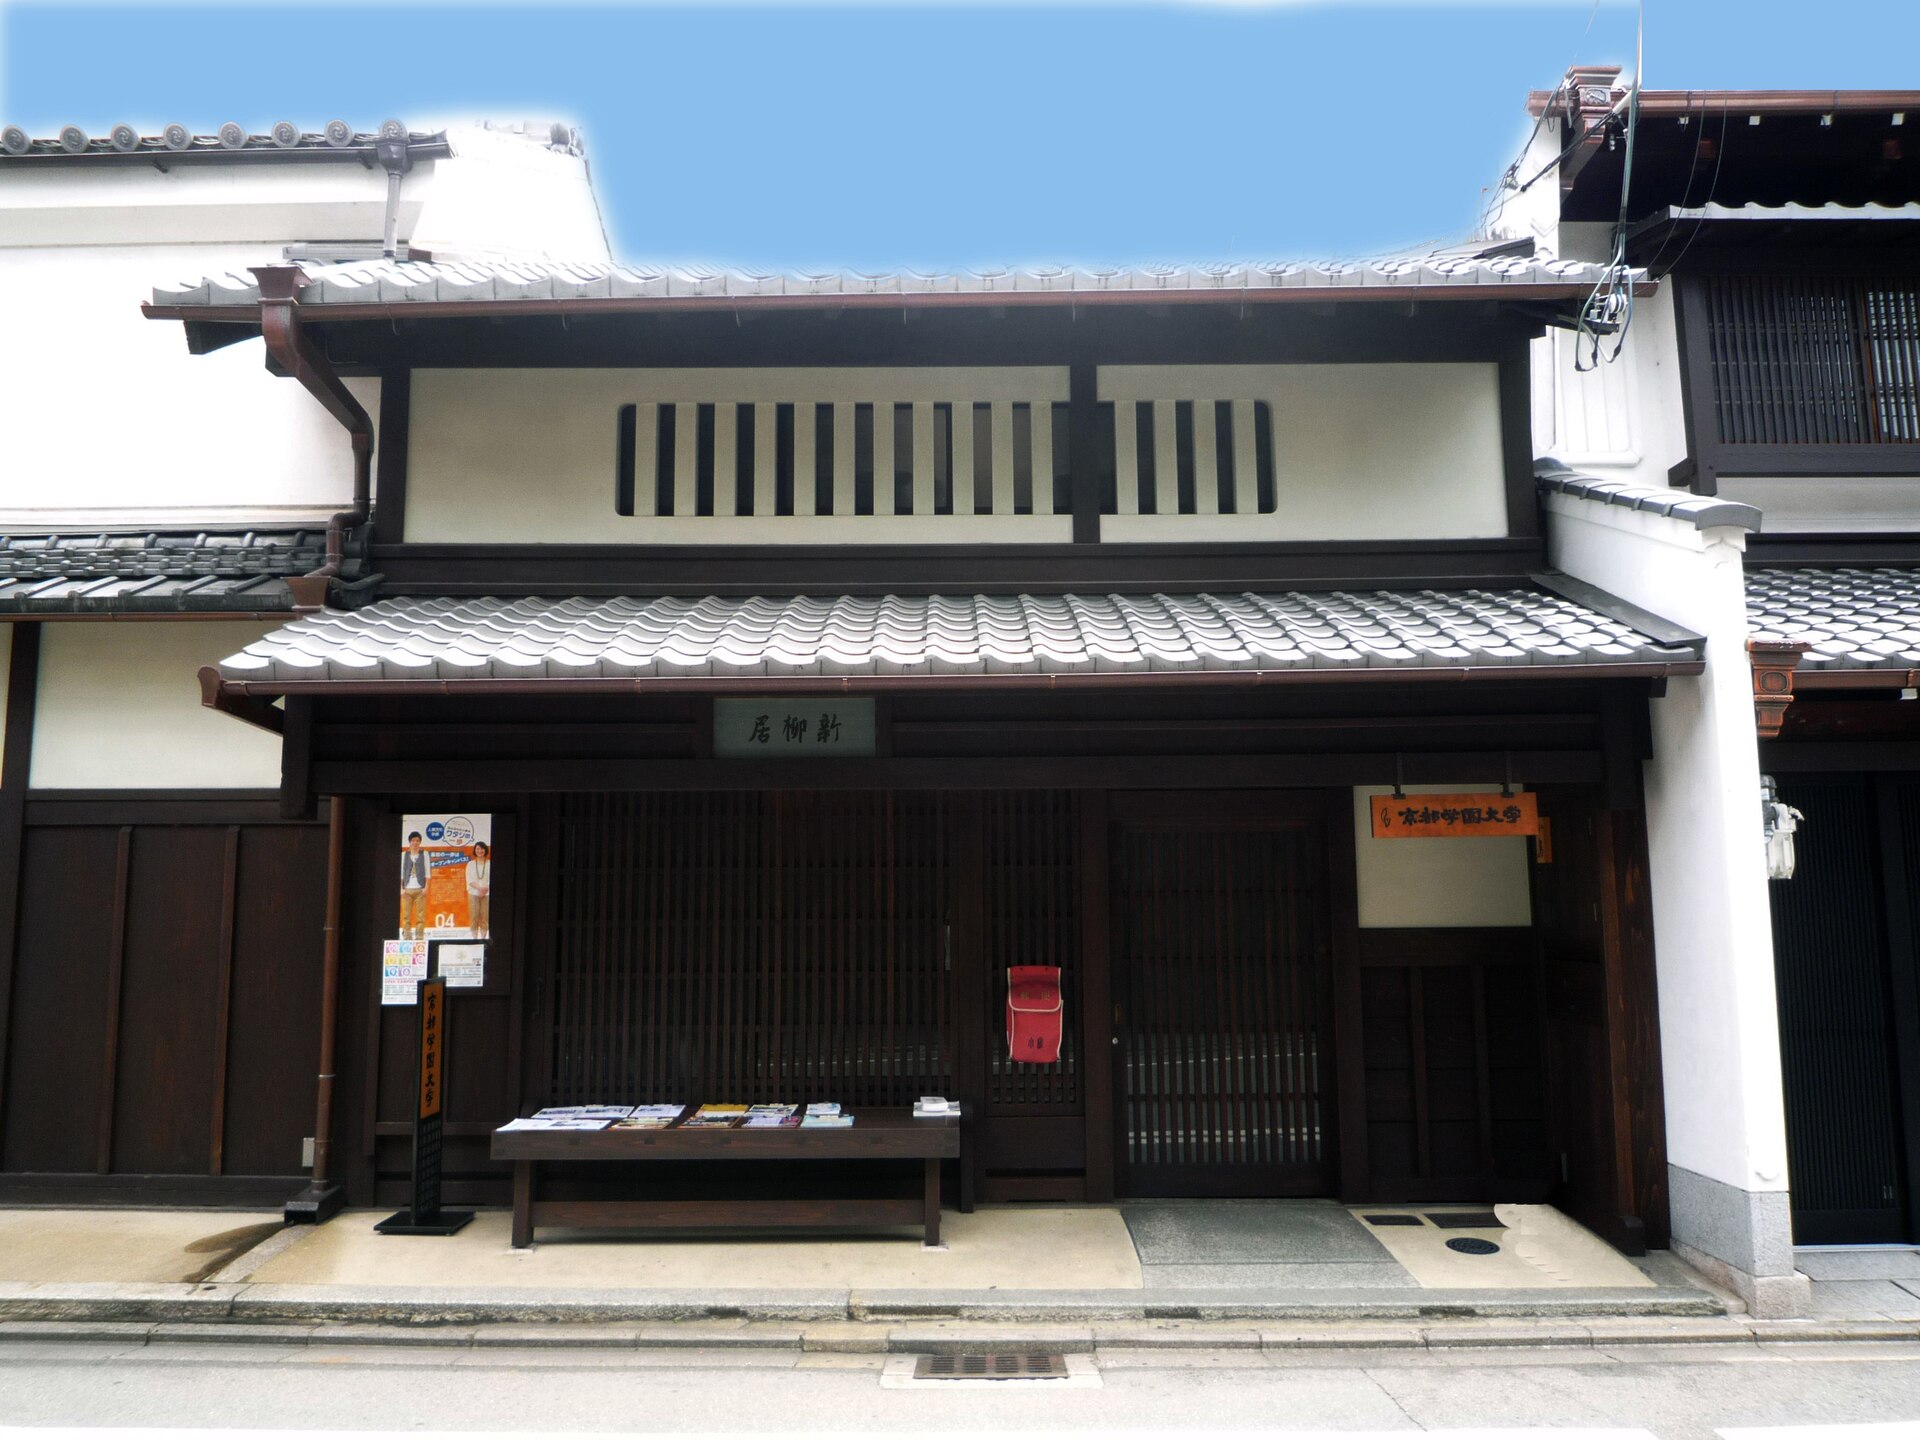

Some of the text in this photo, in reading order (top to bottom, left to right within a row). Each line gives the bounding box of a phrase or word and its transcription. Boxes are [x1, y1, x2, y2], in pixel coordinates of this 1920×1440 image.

[1399, 806, 1521, 825] 京都学園大学
[435, 913, 455, 928] 04
